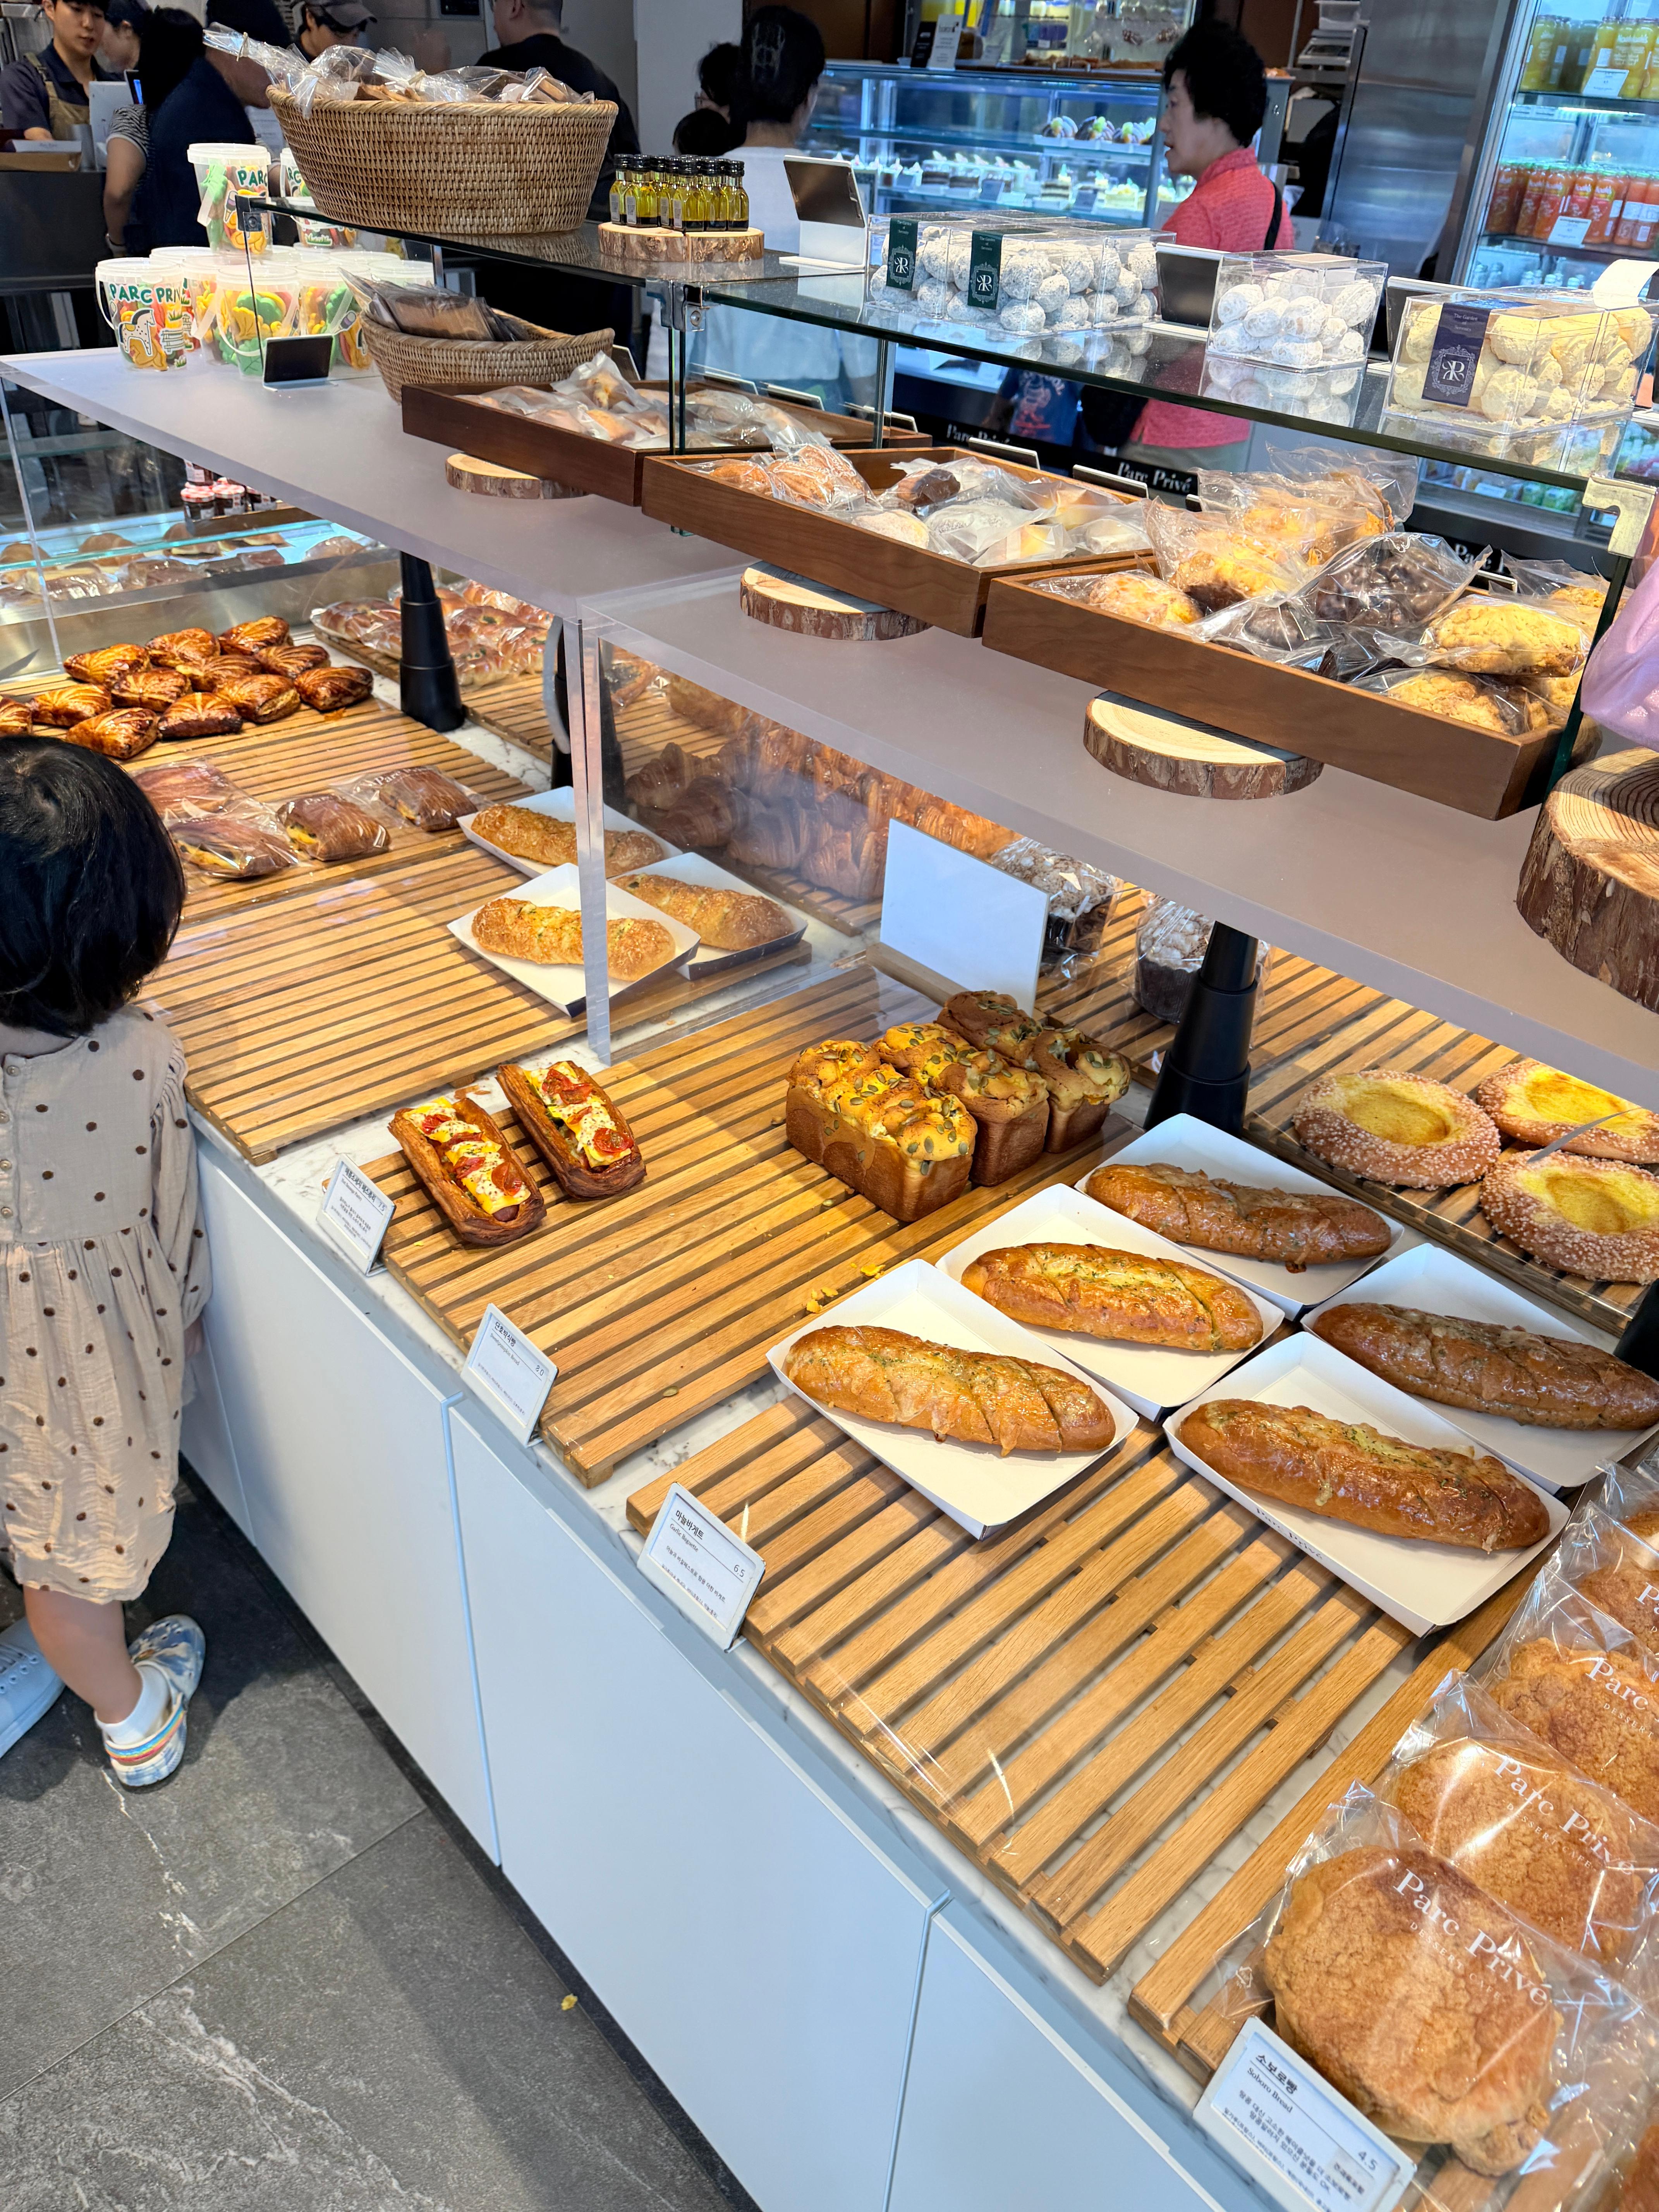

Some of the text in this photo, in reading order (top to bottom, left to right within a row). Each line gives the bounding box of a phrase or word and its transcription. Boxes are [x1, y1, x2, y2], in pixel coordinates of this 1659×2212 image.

[109, 283, 153, 304] PARC
[1118, 462, 1192, 493] Parc Privé
[374, 771, 400, 786] Parc
[670, 1523, 699, 1553] Garlic Baguette
[676, 1510, 745, 1577] 마늘바게트 6.5
[1585, 1657, 1648, 1710] Parc
[1603, 1703, 1654, 1738] DESSERT
[1492, 1757, 1554, 1815] Parc
[1507, 1803, 1557, 1845] DSSERT
[1393, 1869, 1552, 2005] Parc Privé
[1410, 1922, 1463, 1970] DESSERT
[1248, 2068, 1293, 2113] Soboro Bread
[1253, 2103, 1265, 2117] 대신
[1266, 2116, 1285, 2136] 고소한
[1255, 2055, 1377, 2171] 소보로빵 4.5
